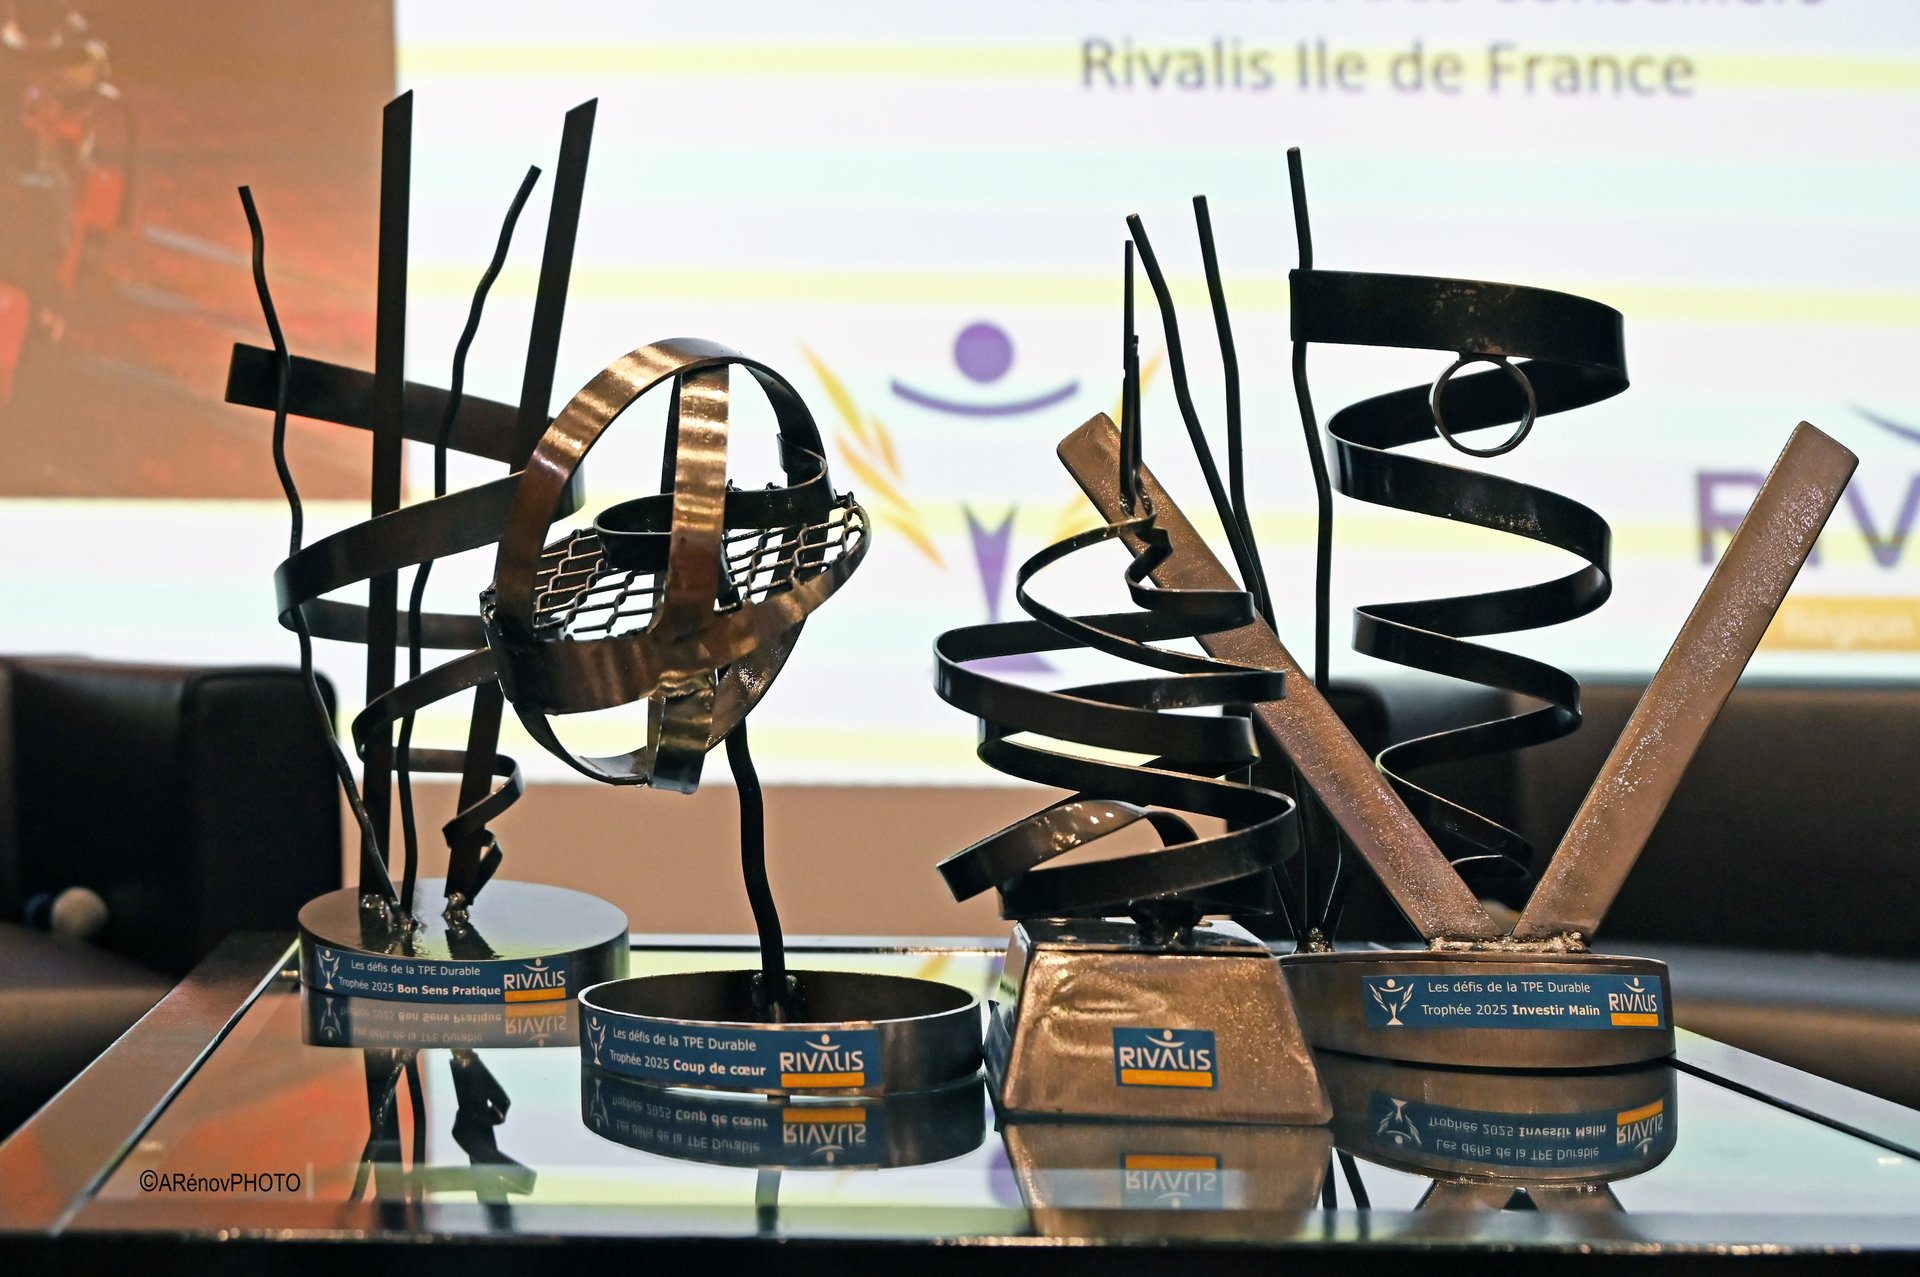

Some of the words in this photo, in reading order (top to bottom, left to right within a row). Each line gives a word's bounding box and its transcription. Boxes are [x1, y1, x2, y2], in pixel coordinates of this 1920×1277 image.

[1080, 35, 1276, 92] Rivalis
[1297, 35, 1368, 92] Ile
[1390, 40, 1464, 95] de
[1488, 41, 1697, 97] France
[351, 960, 365, 971] Les
[367, 961, 388, 973] défis
[391, 964, 403, 974] de
[406, 965, 415, 975] la
[418, 966, 437, 976] TPE
[440, 966, 481, 976] Durable
[338, 976, 369, 990] Trophée
[371, 981, 394, 993] 2025
[397, 984, 418, 994] Bon
[421, 985, 449, 995] Sens
[452, 985, 501, 998] Pratique
[503, 970, 566, 990] RIVALIS
[1428, 981, 1449, 993] Les
[1453, 980, 1483, 993] défis
[1487, 981, 1503, 993] de
[1506, 981, 1518, 993] la
[1521, 981, 1544, 993] TPE
[1548, 981, 1591, 993] Durable
[1421, 1003, 1472, 1018] Trophée
[1476, 1004, 1508, 1016] 2025
[1511, 1004, 1565, 1016] Investir
[1568, 1004, 1600, 1016] Malin
[1608, 993, 1658, 1013] RIVALIS
[613, 1027, 627, 1040] Les
[628, 1029, 650, 1044] défis
[653, 1034, 666, 1045] de
[669, 1035, 679, 1047] la
[682, 1036, 704, 1049] TPE
[708, 1037, 757, 1051] Durable
[609, 1049, 642, 1066] Trophée
[644, 1055, 670, 1070] 2025
[673, 1059, 706, 1075] Coup
[709, 1062, 726, 1075] de
[730, 1064, 767, 1076] cœur
[779, 1050, 865, 1072] RIVALIS
[1119, 1047, 1212, 1070] RIVALIS
